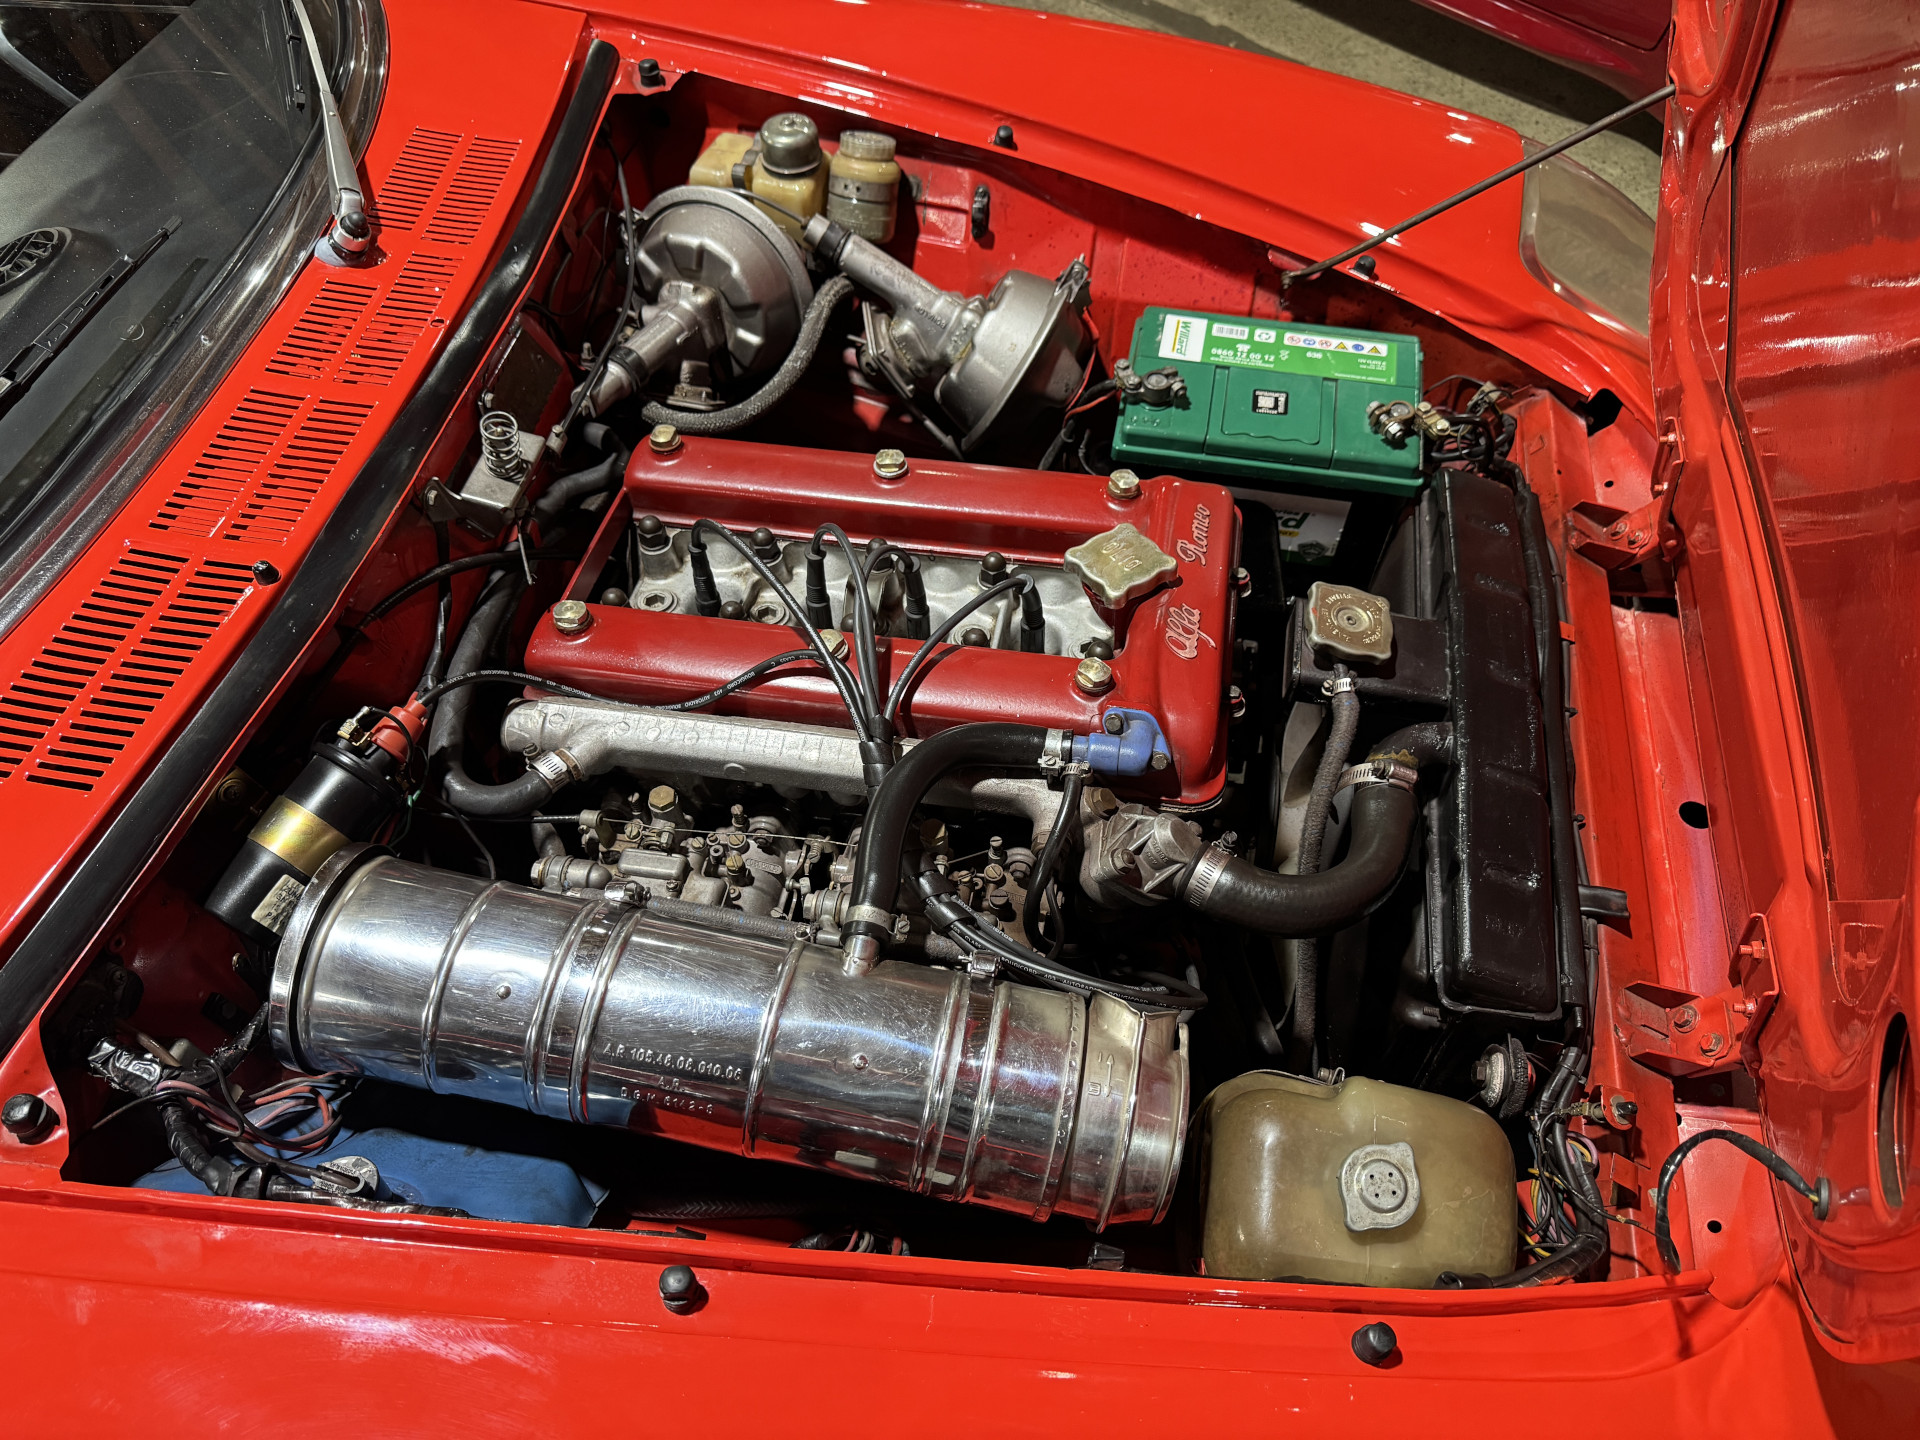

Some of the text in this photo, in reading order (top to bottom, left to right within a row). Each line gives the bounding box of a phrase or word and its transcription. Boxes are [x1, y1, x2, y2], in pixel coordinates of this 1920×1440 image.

[1176, 320, 1192, 356] Willard
[1165, 503, 1217, 660] Alfa Romeo
[727, 671, 756, 689] BOUGICORD
[684, 695, 710, 708] AUTORADIO
